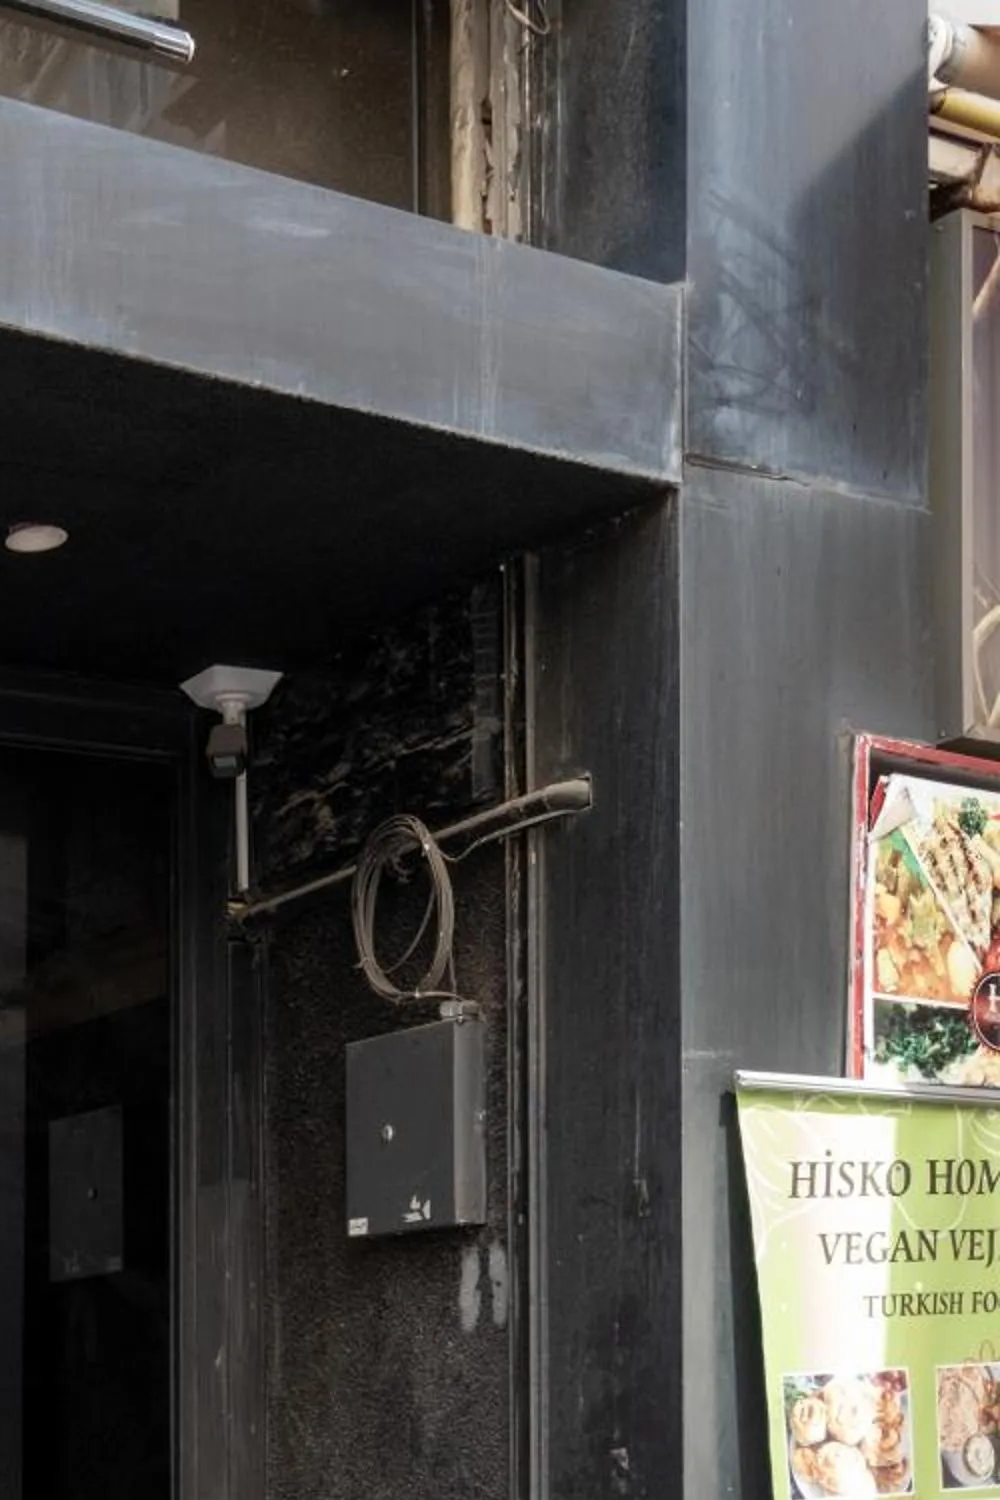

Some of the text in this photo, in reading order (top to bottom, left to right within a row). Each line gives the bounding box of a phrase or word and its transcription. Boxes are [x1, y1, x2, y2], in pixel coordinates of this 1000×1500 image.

[818, 1228, 1000, 1268] VEGAN VEJ
[863, 1291, 1000, 1318] TURKISH FO
